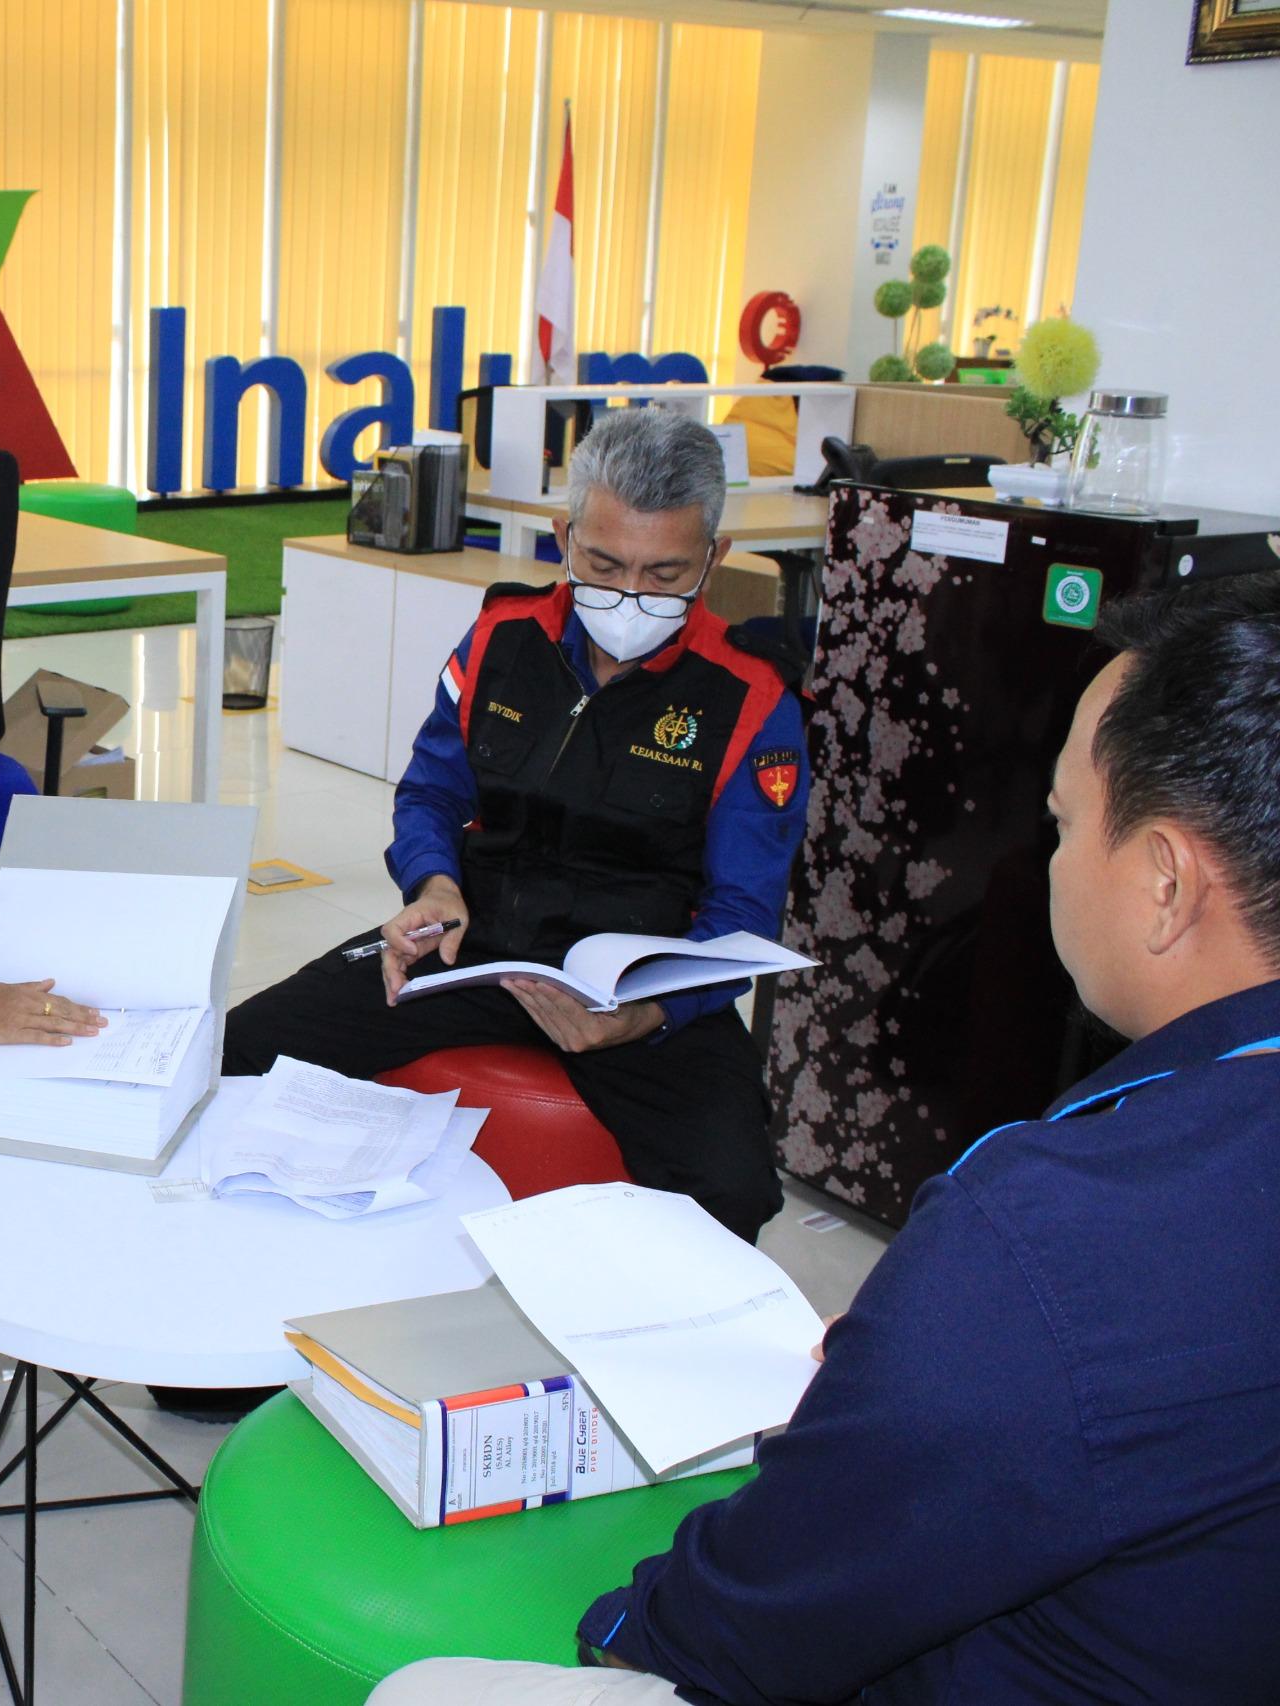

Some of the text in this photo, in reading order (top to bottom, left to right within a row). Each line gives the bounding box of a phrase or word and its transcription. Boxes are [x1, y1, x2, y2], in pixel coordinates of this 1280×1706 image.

[147, 306, 709, 493] Inal
[629, 744, 703, 772] KEJAKSAAN RI
[483, 1434, 492, 1478] SKBDN
